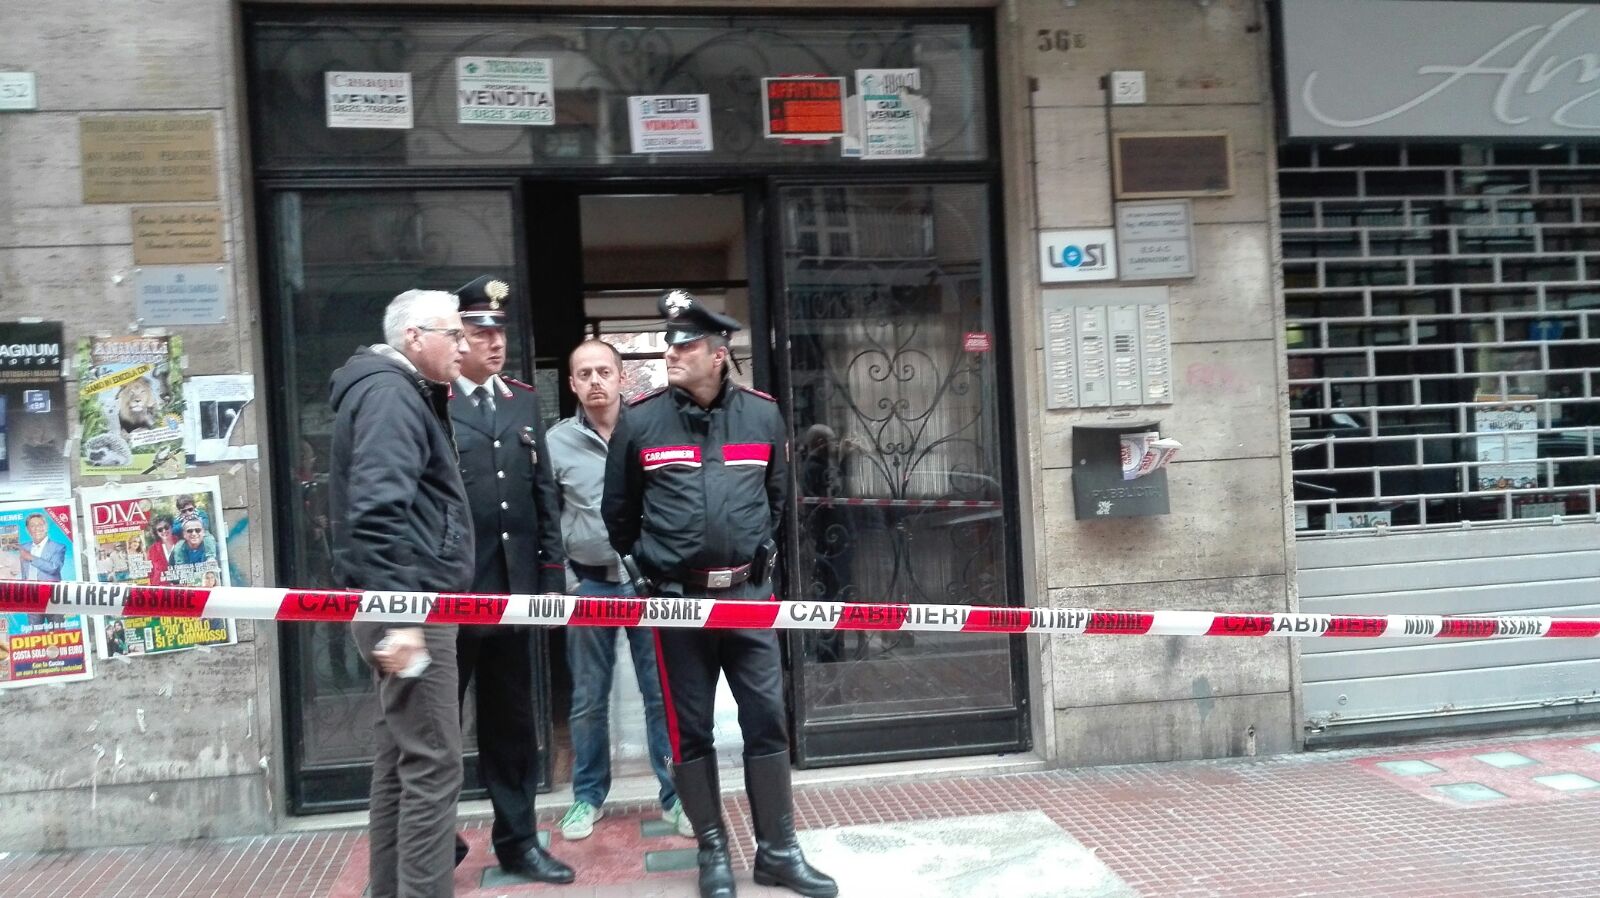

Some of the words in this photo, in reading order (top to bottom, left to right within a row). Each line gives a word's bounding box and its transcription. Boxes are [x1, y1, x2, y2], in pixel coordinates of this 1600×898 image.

[2, 83, 30, 98] 52
[332, 93, 408, 104] VENDE
[459, 89, 552, 107] VENDITA
[867, 110, 914, 119] VENDE
[1047, 243, 1107, 268] LOSI
[93, 501, 147, 526] DIVA
[50, 584, 195, 609] OLTREPASSARE
[299, 592, 504, 616] CARABINIERI
[528, 596, 565, 618] NON
[574, 597, 701, 620] OLTREPASSARE
[789, 602, 966, 625] CARABINIERI
[989, 608, 1021, 627] NON
[1029, 609, 1143, 630] OLTREPASSARE
[1223, 614, 1387, 634] CARABINIERI
[1404, 617, 1434, 635] NON
[1441, 617, 1543, 636] OLTREPASSARE
[155, 625, 161, 637] E
[182, 619, 210, 634] CARLO
[156, 635, 166, 648] SI
[177, 628, 227, 645] COMMOSSO
[12, 649, 31, 660] COSTA
[32, 648, 47, 658] SOLO
[59, 646, 68, 655] UN
[68, 645, 83, 655] EURO
